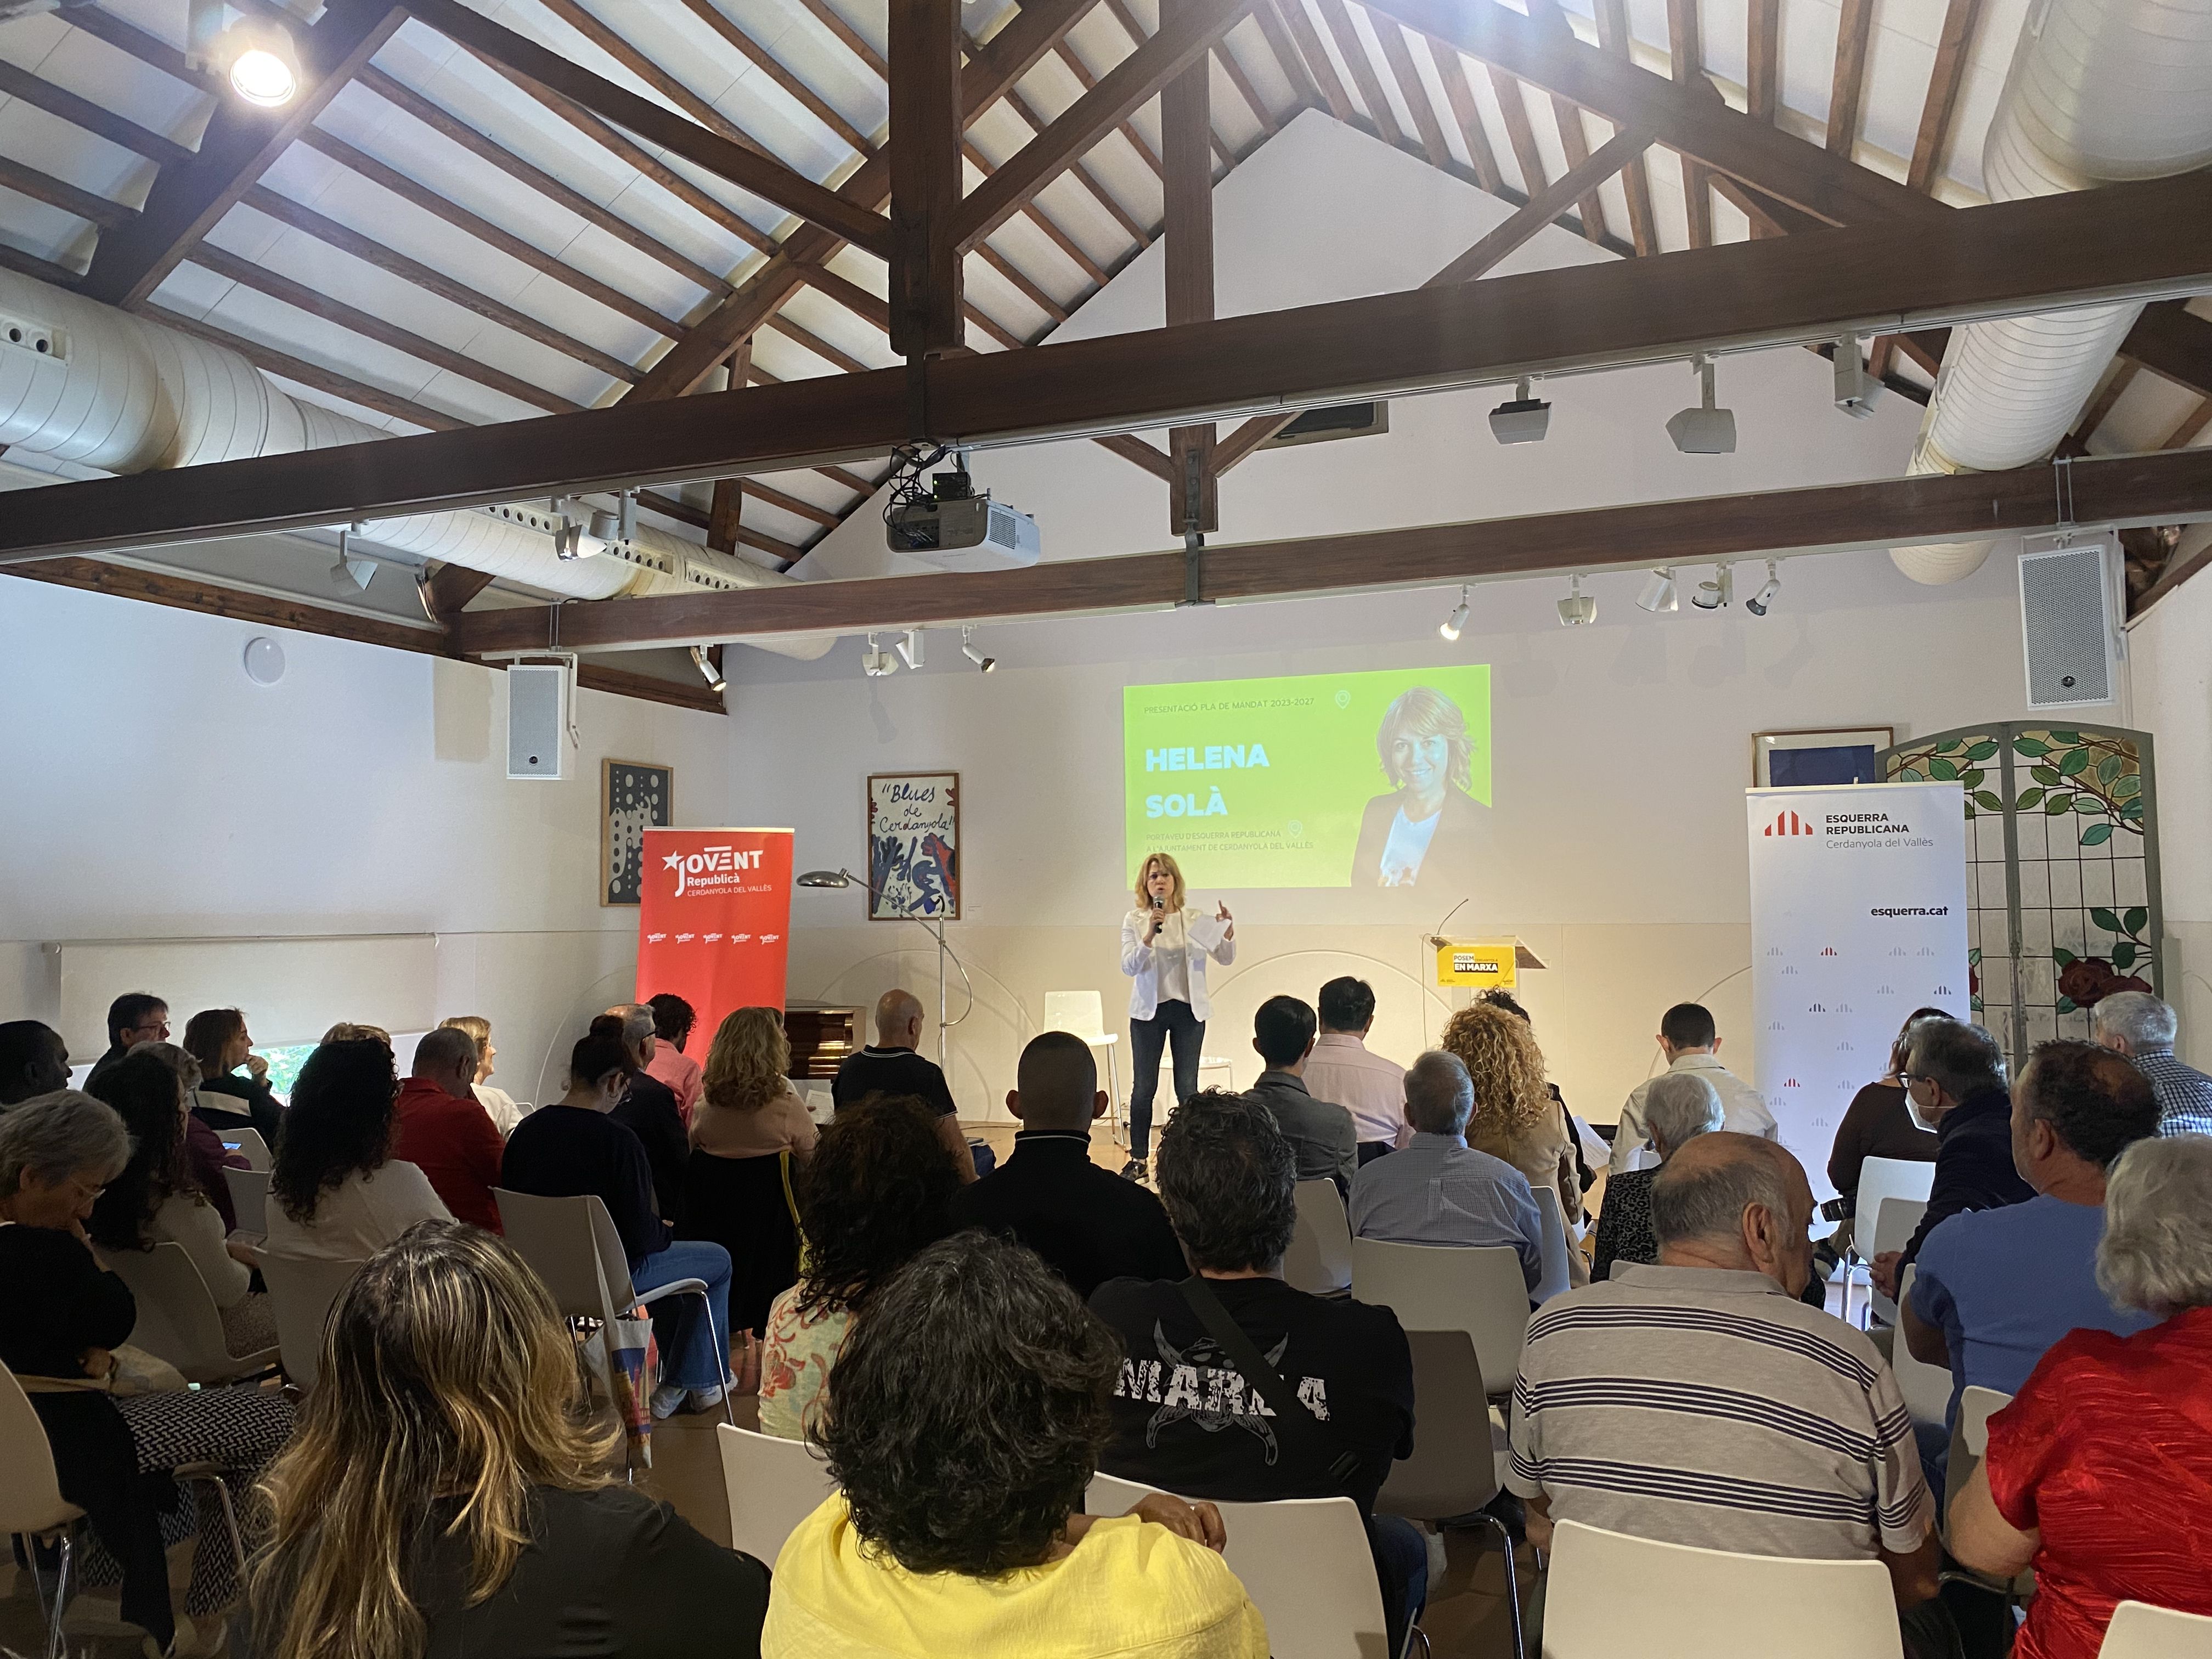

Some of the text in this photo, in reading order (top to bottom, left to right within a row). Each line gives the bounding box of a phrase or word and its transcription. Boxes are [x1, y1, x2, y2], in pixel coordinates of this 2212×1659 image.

[1144, 702, 1198, 714] PRESENTACIÓ
[1232, 700, 1268, 709] MANDAT
[1270, 697, 1314, 708] 2023-2027
[1146, 743, 1270, 772] HELENA
[1145, 785, 1228, 819] SOLÀ
[903, 804, 922, 817] de
[1826, 812, 1889, 823] ESQUERRA
[1146, 832, 1184, 841] PORTAVEU
[1231, 830, 1282, 839] REPUBLICANA
[1826, 824, 1910, 835] REPUBLICANA
[1220, 843, 1268, 851] CERDANYOLA
[1285, 841, 1314, 849] VALLÈS
[1826, 837, 1934, 850] Cerdanyola del Vallès
[675, 845, 764, 898] JOVENT
[687, 872, 740, 888] Republicà
[687, 883, 772, 897] CERDANYOLA DEL VALLÈS
[1870, 906, 1949, 918] esquerra.cat
[1454, 963, 1466, 971] EN
